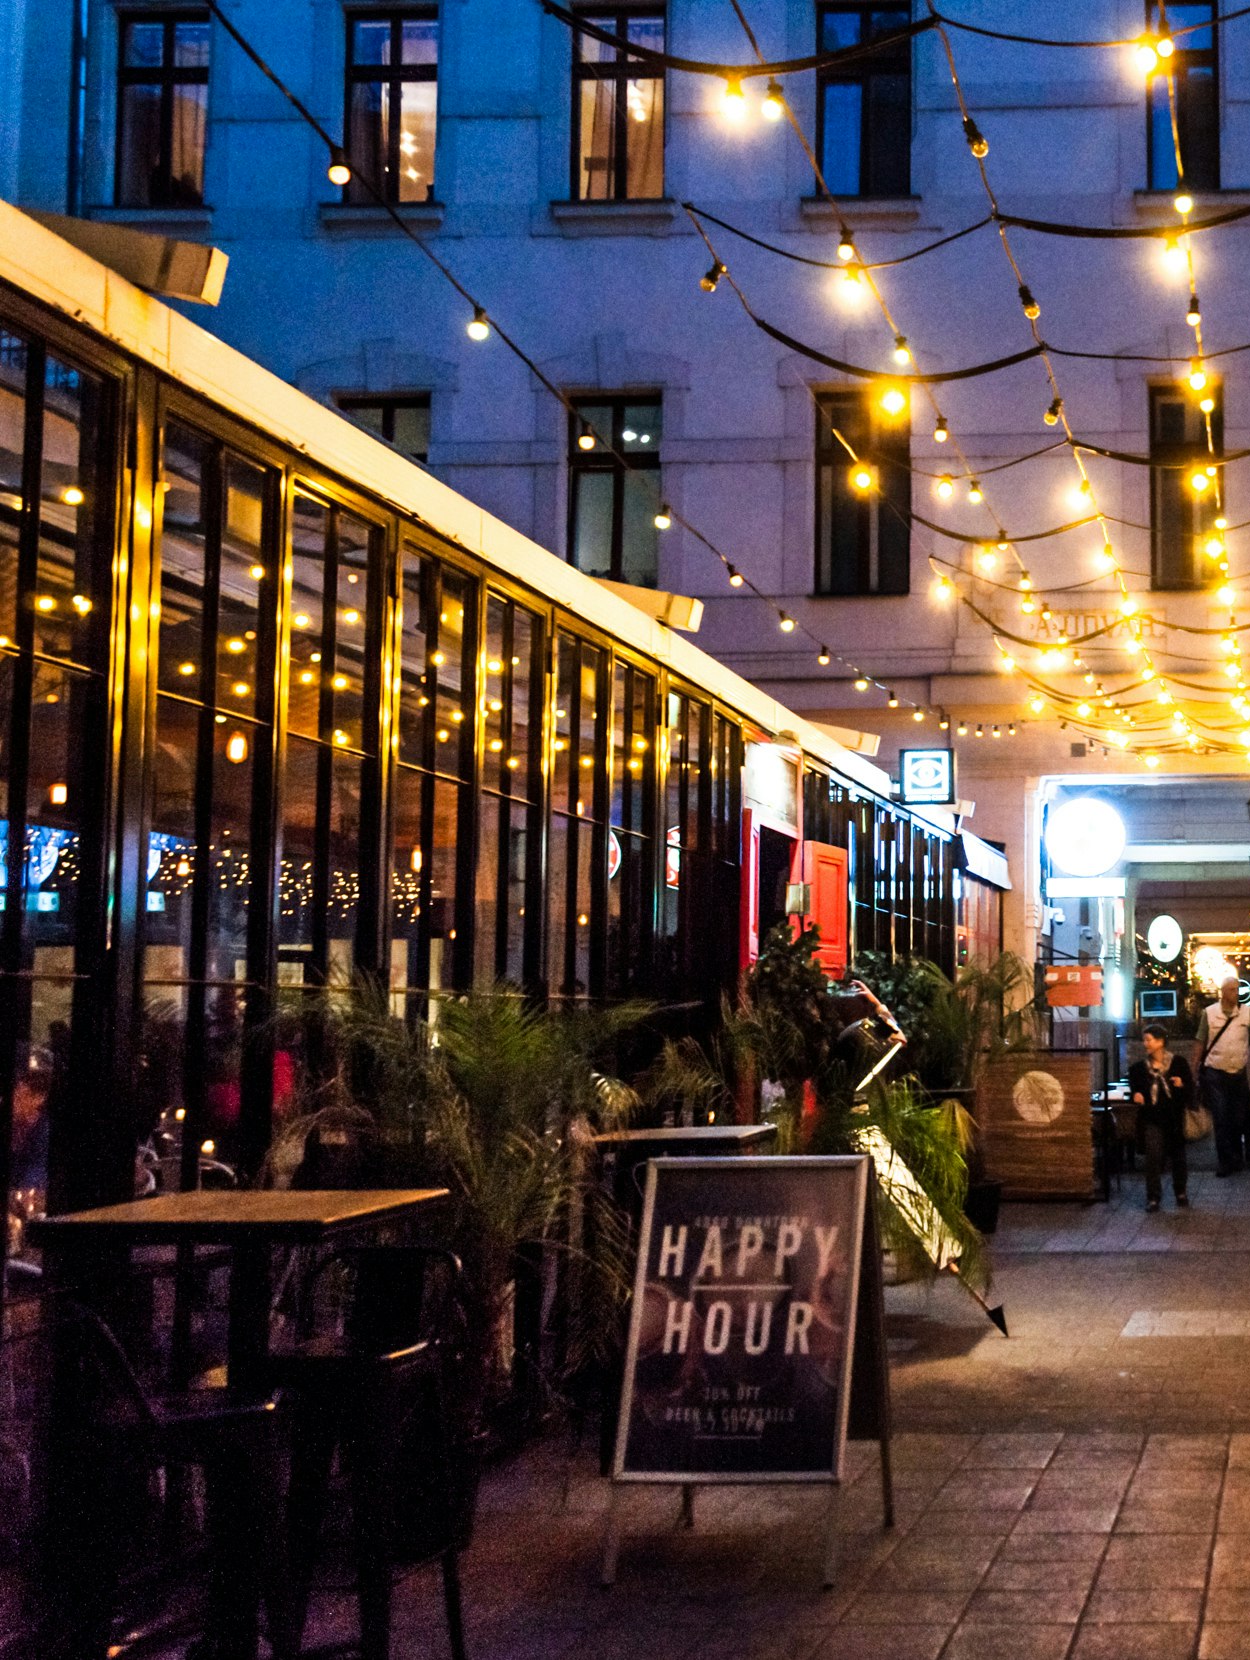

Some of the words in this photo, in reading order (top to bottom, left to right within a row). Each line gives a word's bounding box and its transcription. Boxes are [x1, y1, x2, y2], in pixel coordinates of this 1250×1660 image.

[657, 1225, 839, 1278] HAPPY
[663, 1301, 814, 1355] HOUR
[736, 1386, 761, 1401] OFF
[721, 1407, 796, 1423] COCKTAILS
